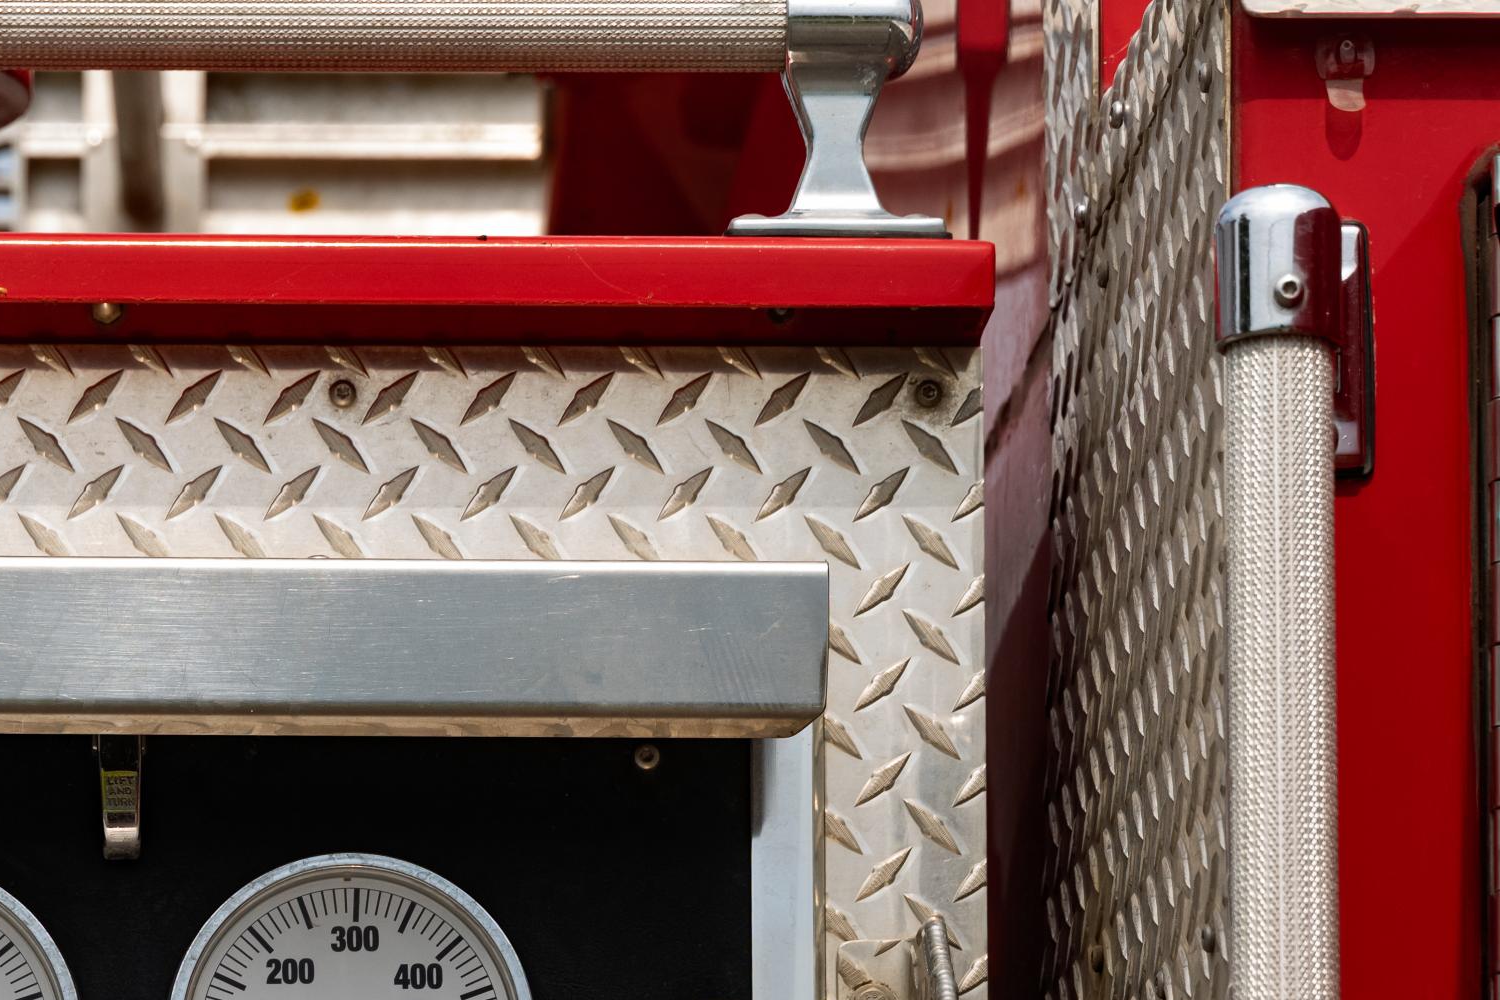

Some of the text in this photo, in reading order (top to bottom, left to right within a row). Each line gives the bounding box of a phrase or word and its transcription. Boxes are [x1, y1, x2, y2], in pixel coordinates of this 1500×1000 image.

[108, 776, 134, 785] LIFT
[108, 787, 132, 796] AND
[331, 926, 379, 952] 300
[266, 958, 315, 985] 200
[394, 963, 443, 990] 400
